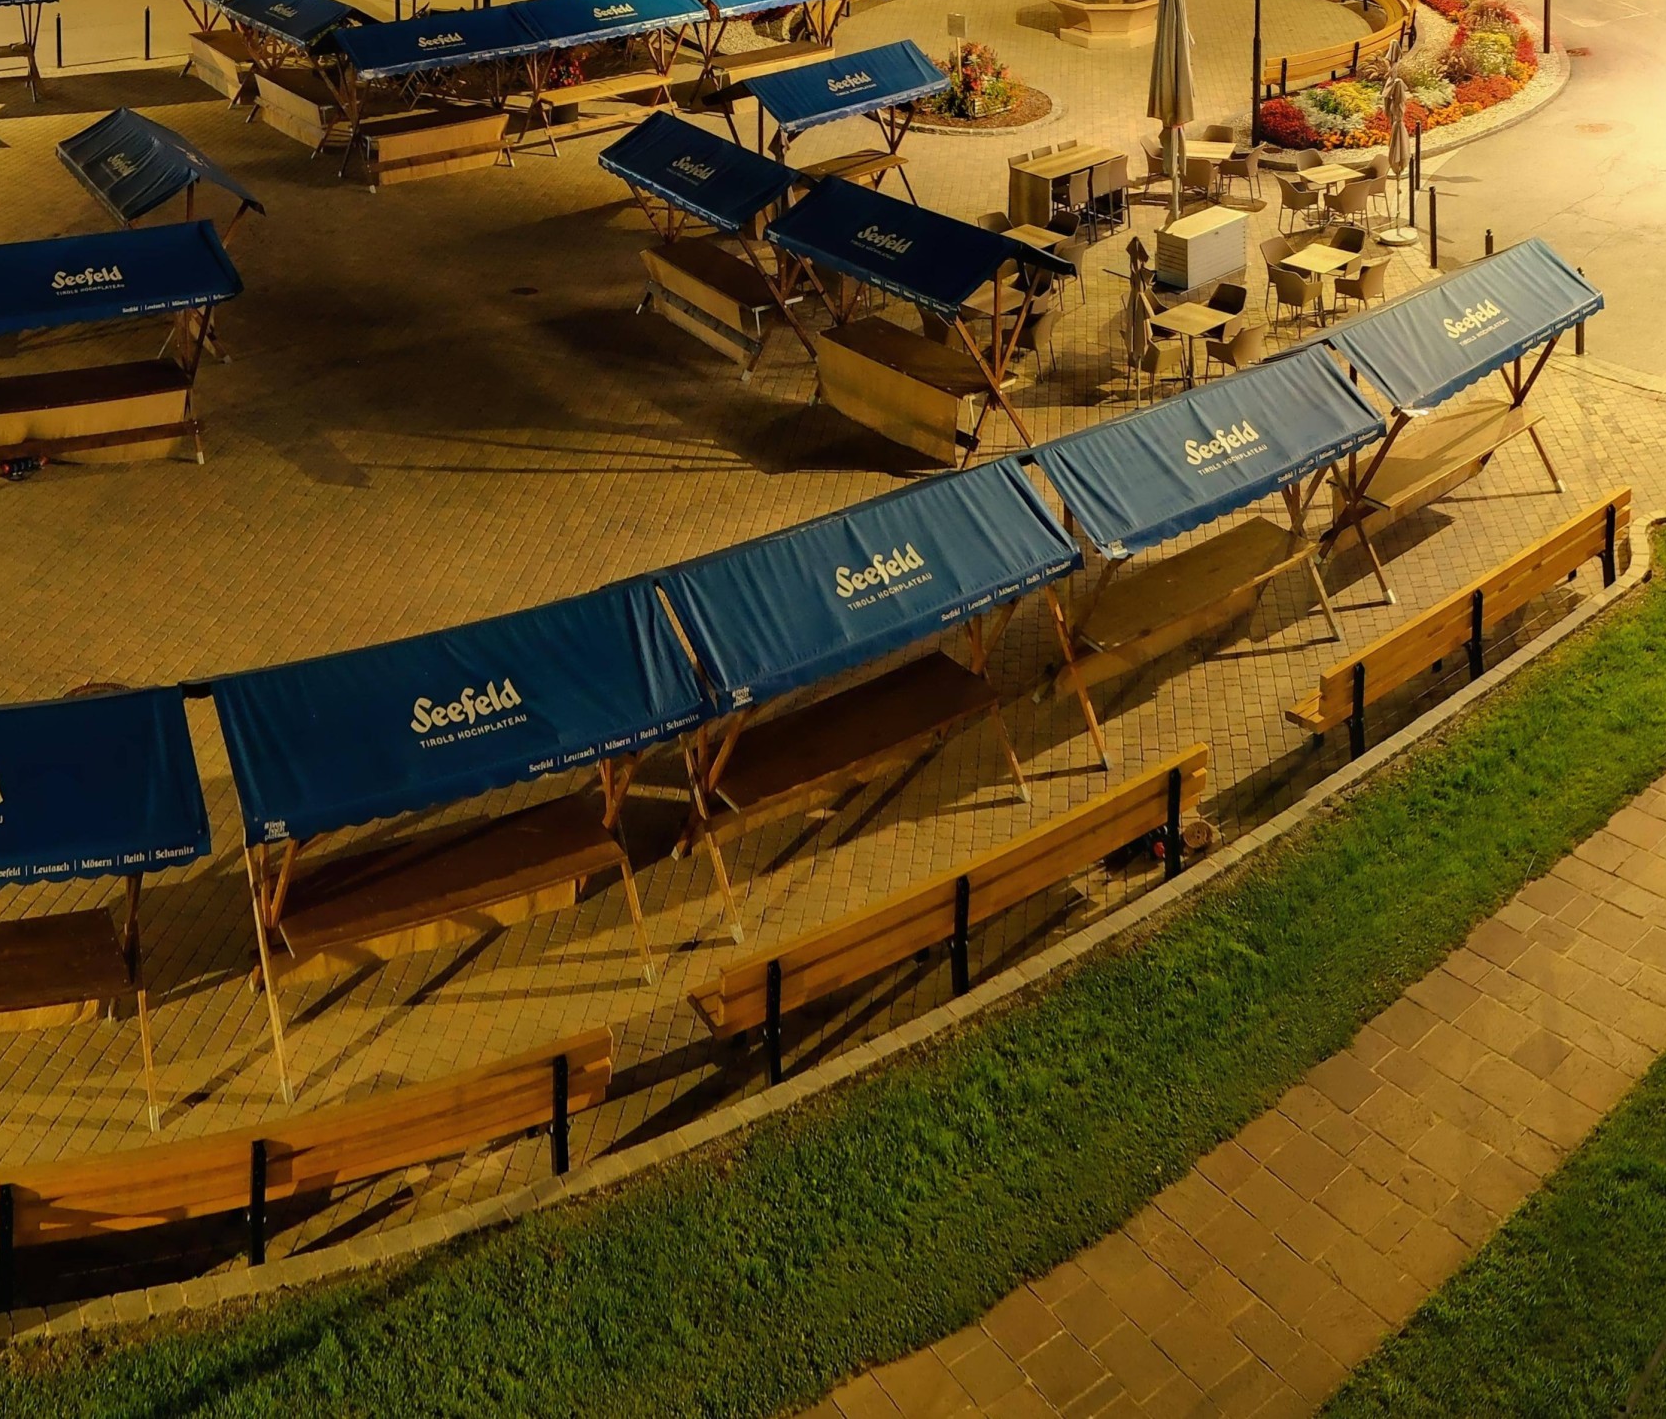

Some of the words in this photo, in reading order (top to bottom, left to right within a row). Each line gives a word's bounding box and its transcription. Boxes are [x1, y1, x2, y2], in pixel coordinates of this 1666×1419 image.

[417, 32, 464, 48] Seefeld
[827, 71, 873, 92] Seefeld
[856, 225, 914, 254] Seefeld
[51, 265, 124, 289] Seefeld
[1443, 298, 1502, 339] Seefeld
[1184, 420, 1260, 466] Seefeld
[835, 541, 926, 599] Seefeld
[847, 594, 877, 612] TIROLS
[876, 571, 934, 600] HOCHPLATEAU
[409, 677, 523, 734] Seefeld
[419, 733, 456, 749] TIROLS
[457, 713, 529, 742] HOCHPLATEAU
[32, 861, 70, 876] Leutasch
[80, 856, 113, 870] Mösern
[123, 852, 146, 865] Reith
[154, 845, 195, 861] Scharnitz
